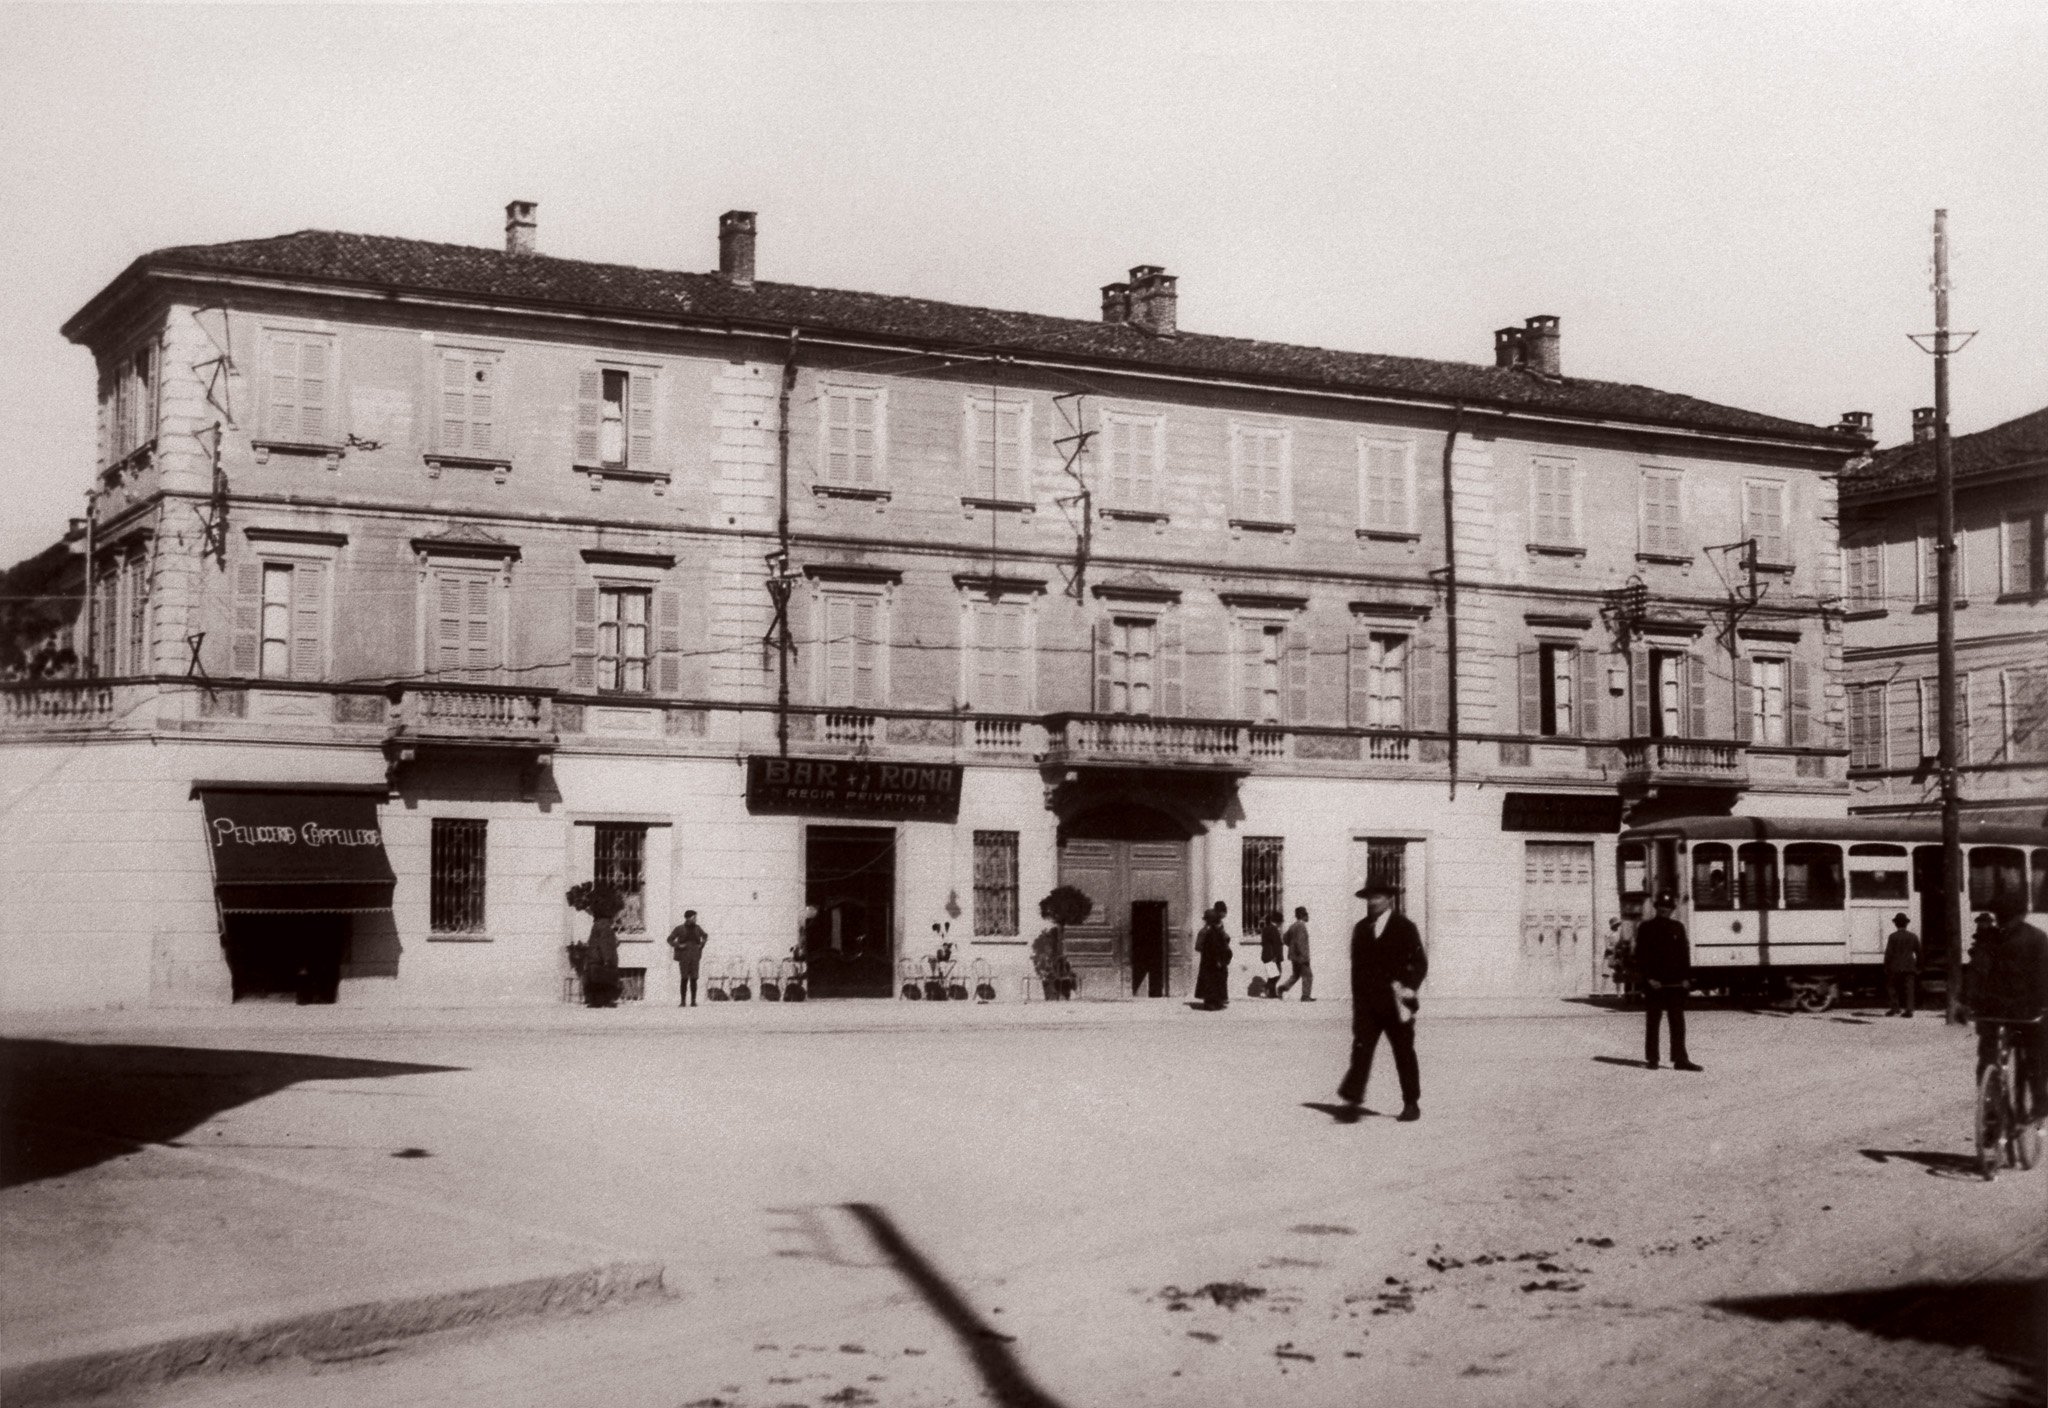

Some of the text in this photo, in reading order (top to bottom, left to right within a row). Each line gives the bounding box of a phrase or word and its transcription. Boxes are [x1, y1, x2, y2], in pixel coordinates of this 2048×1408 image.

[765, 759, 953, 793] BAR ROMA
[786, 788, 927, 804] REGIA PRIVATIVA
